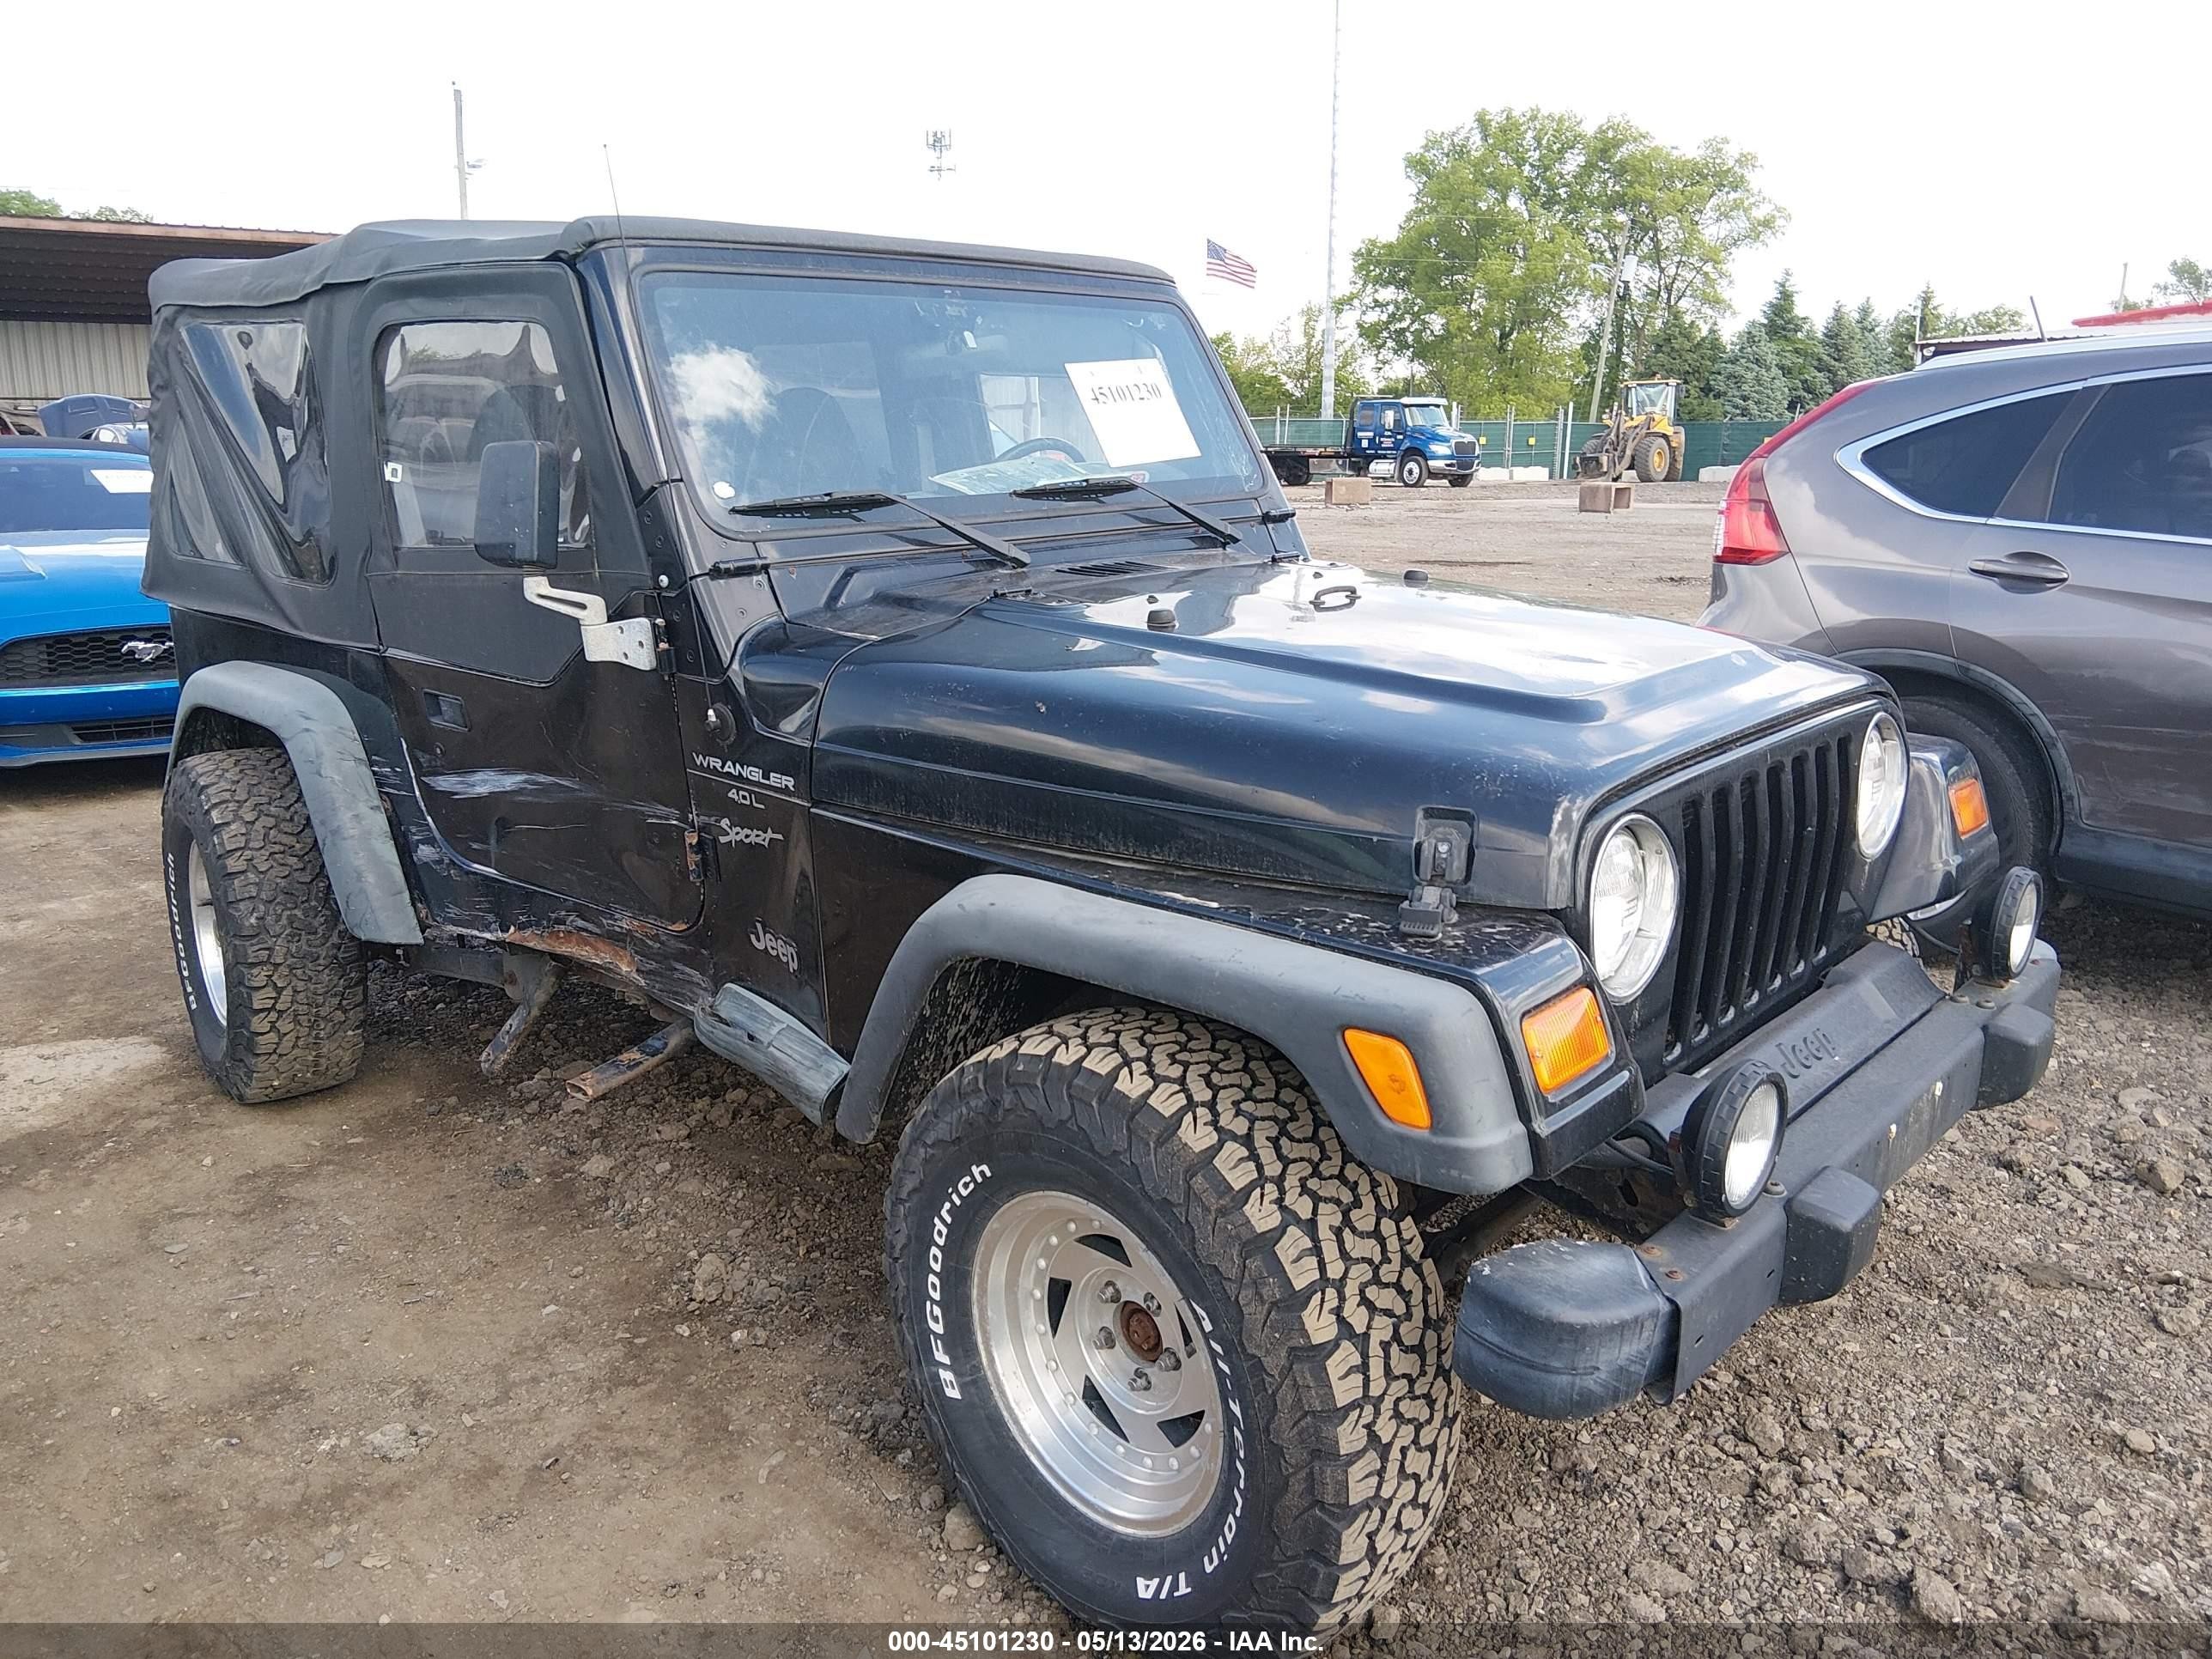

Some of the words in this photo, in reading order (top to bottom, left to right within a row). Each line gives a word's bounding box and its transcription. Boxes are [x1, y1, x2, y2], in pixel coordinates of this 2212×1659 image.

[1091, 383, 1162, 404] 45101230
[692, 752, 795, 792] WRANGLER
[750, 919, 799, 973] Jeep
[1774, 1028, 1837, 1079] Jeep
[926, 1163, 993, 1401] BFGoodrich
[1188, 1297, 1245, 1574] All-Terrain
[1136, 1571, 1192, 1600] T/A
